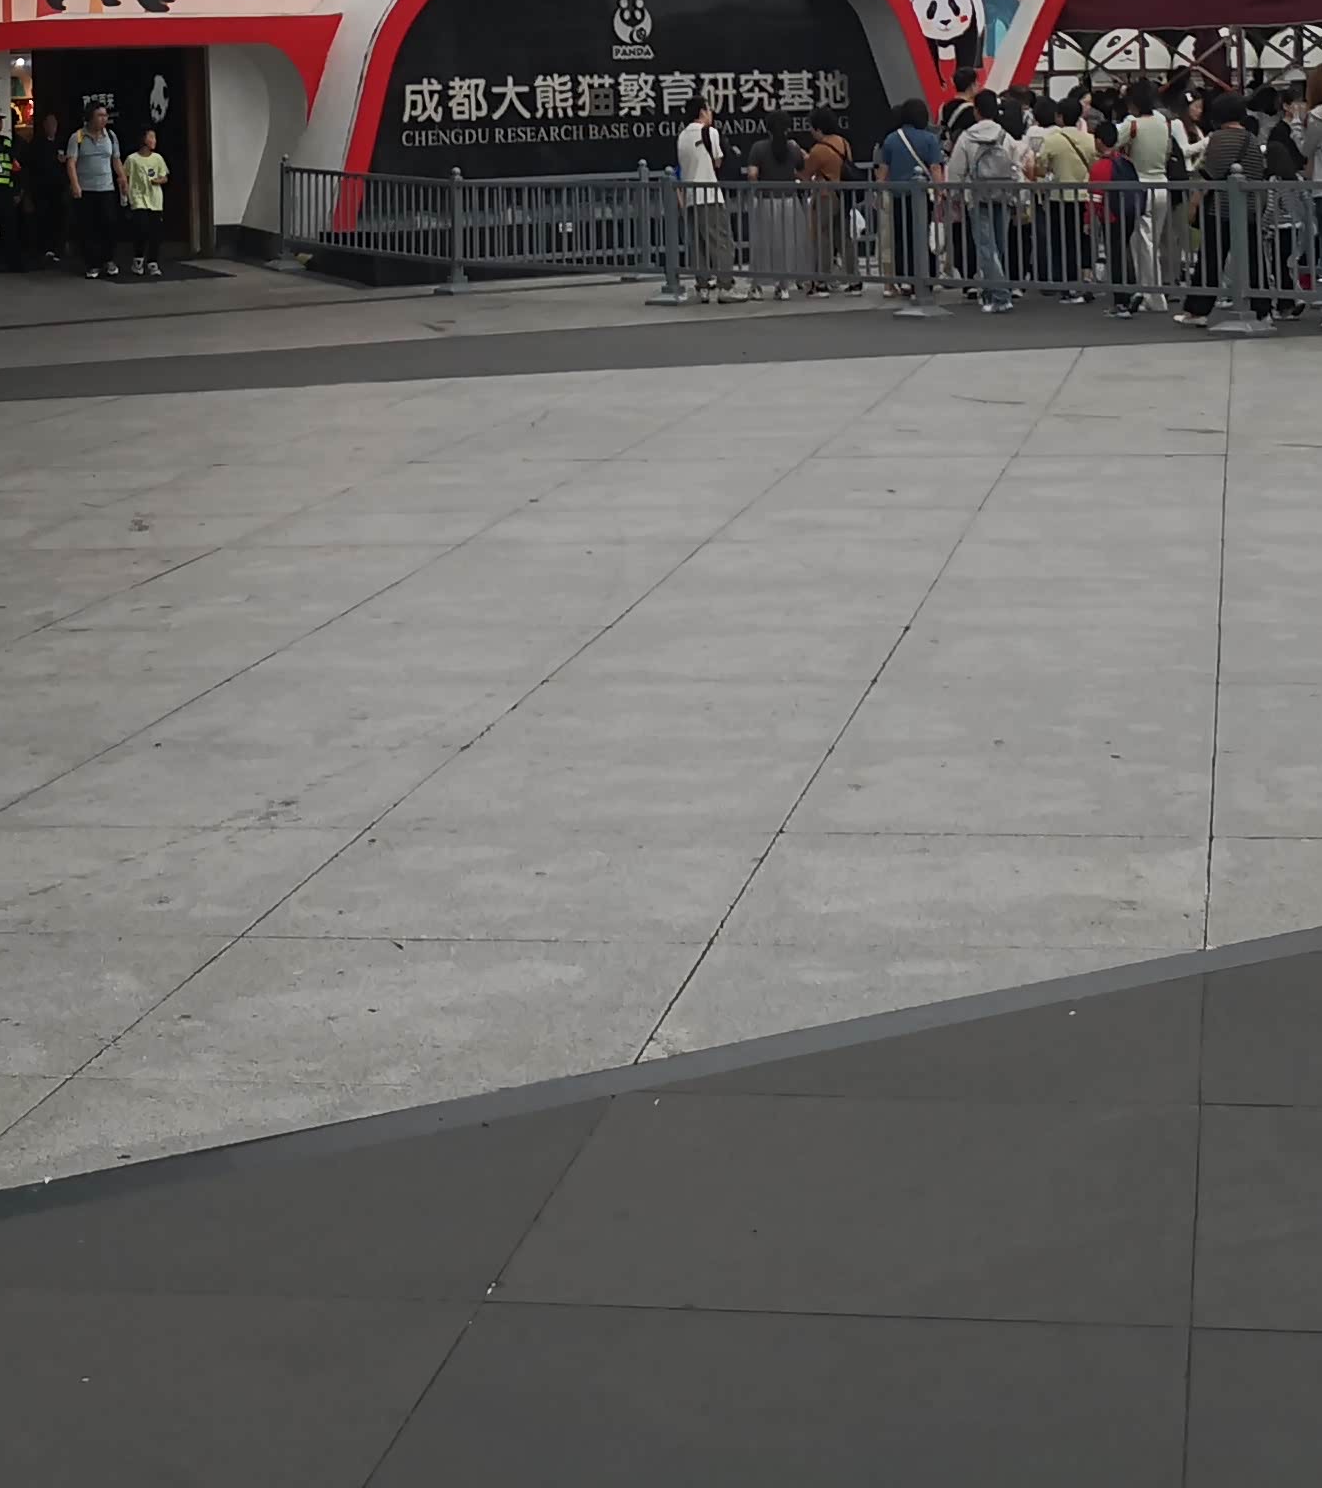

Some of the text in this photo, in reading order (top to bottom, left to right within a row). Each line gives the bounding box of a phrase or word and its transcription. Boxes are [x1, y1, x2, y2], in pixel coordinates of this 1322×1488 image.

[613, 45, 654, 59] PANDA
[403, 69, 850, 123] 成都大熊猫繁育研究基地
[402, 128, 489, 146] CHENGDU
[494, 124, 584, 143] RESEARCH
[589, 123, 629, 140] BASE
[633, 122, 655, 138] OF
[658, 121, 686, 137] GIA
